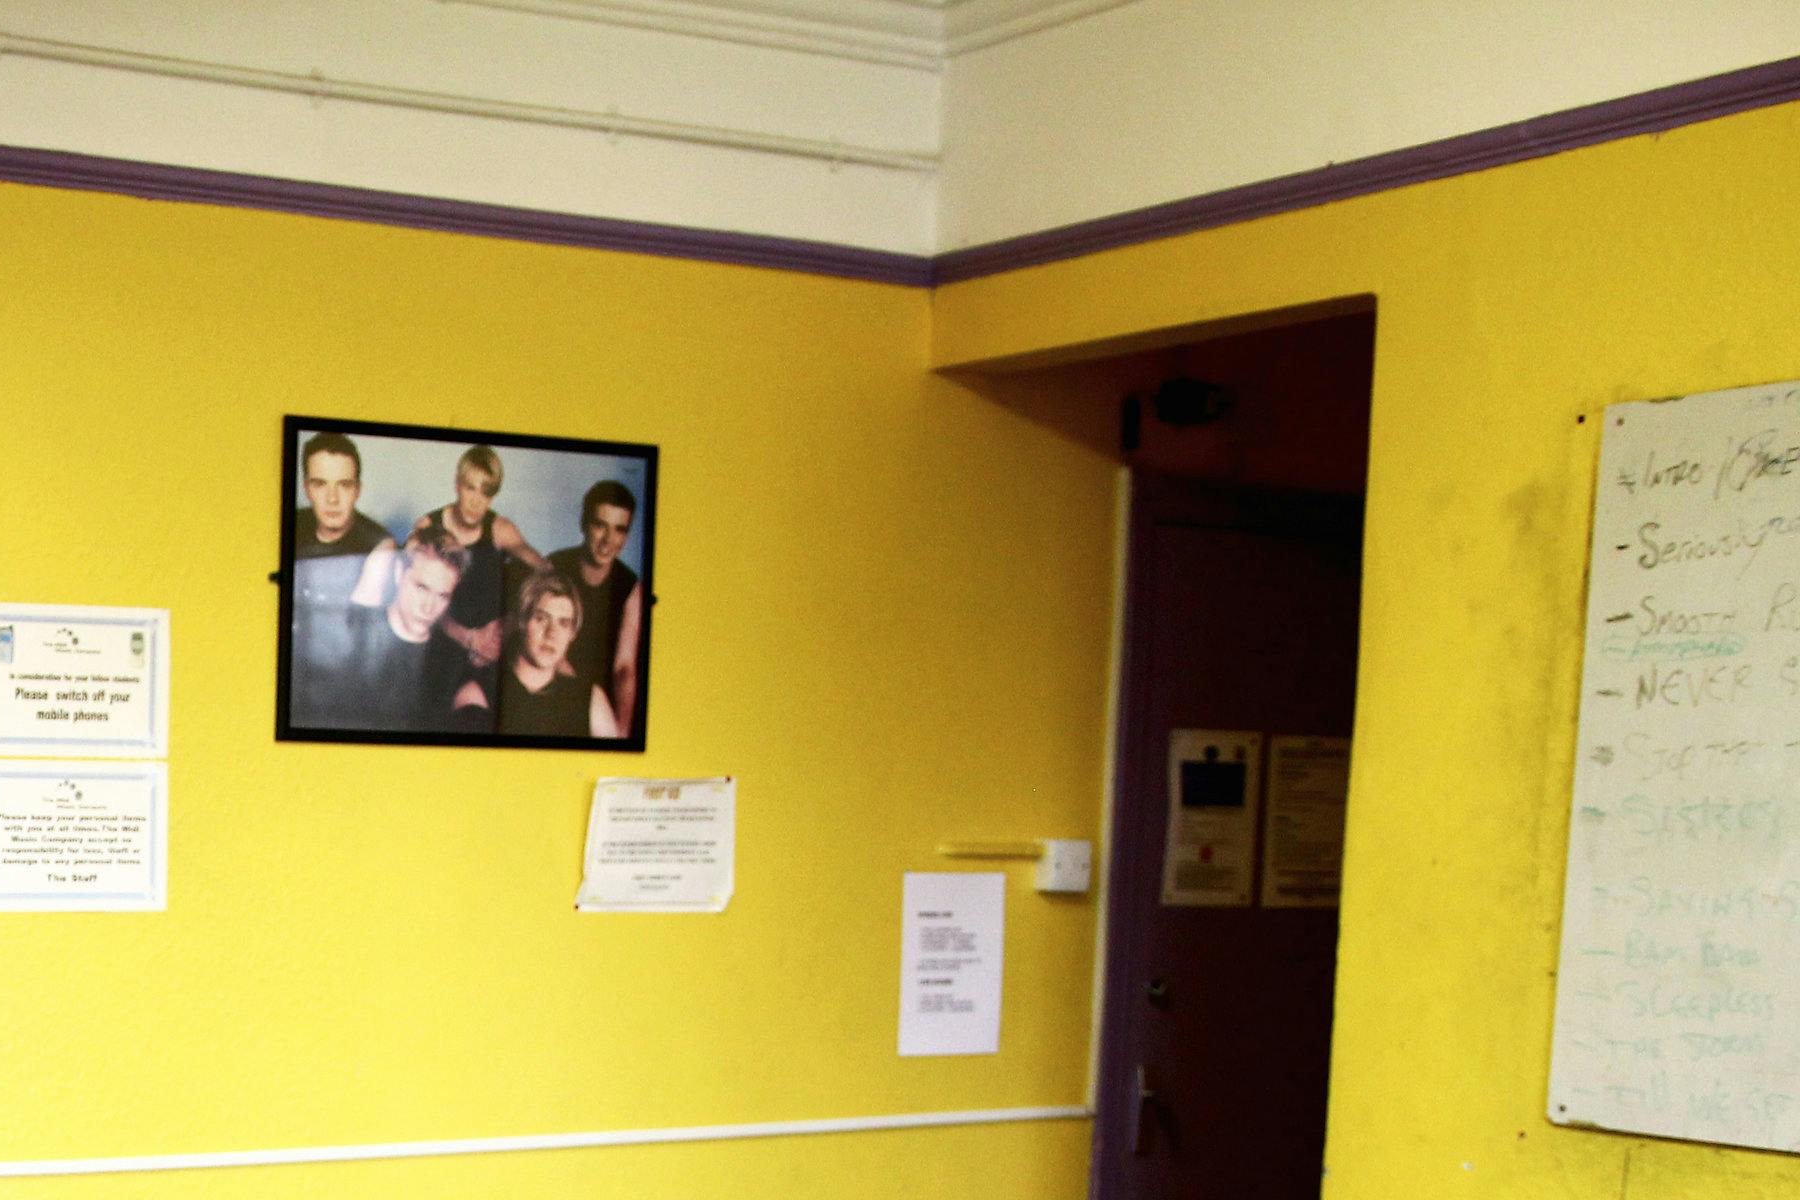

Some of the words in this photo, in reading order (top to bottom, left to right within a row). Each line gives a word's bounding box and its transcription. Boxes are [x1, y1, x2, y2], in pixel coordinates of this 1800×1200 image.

[1635, 662, 1753, 712] NEVER
[14, 687, 48, 701] Please
[55, 689, 89, 702] switch
[92, 688, 105, 702] off
[109, 692, 130, 705] your
[36, 706, 70, 720] mobile
[73, 708, 109, 723] phones
[47, 873, 67, 882] The
[71, 873, 98, 882] Staff
